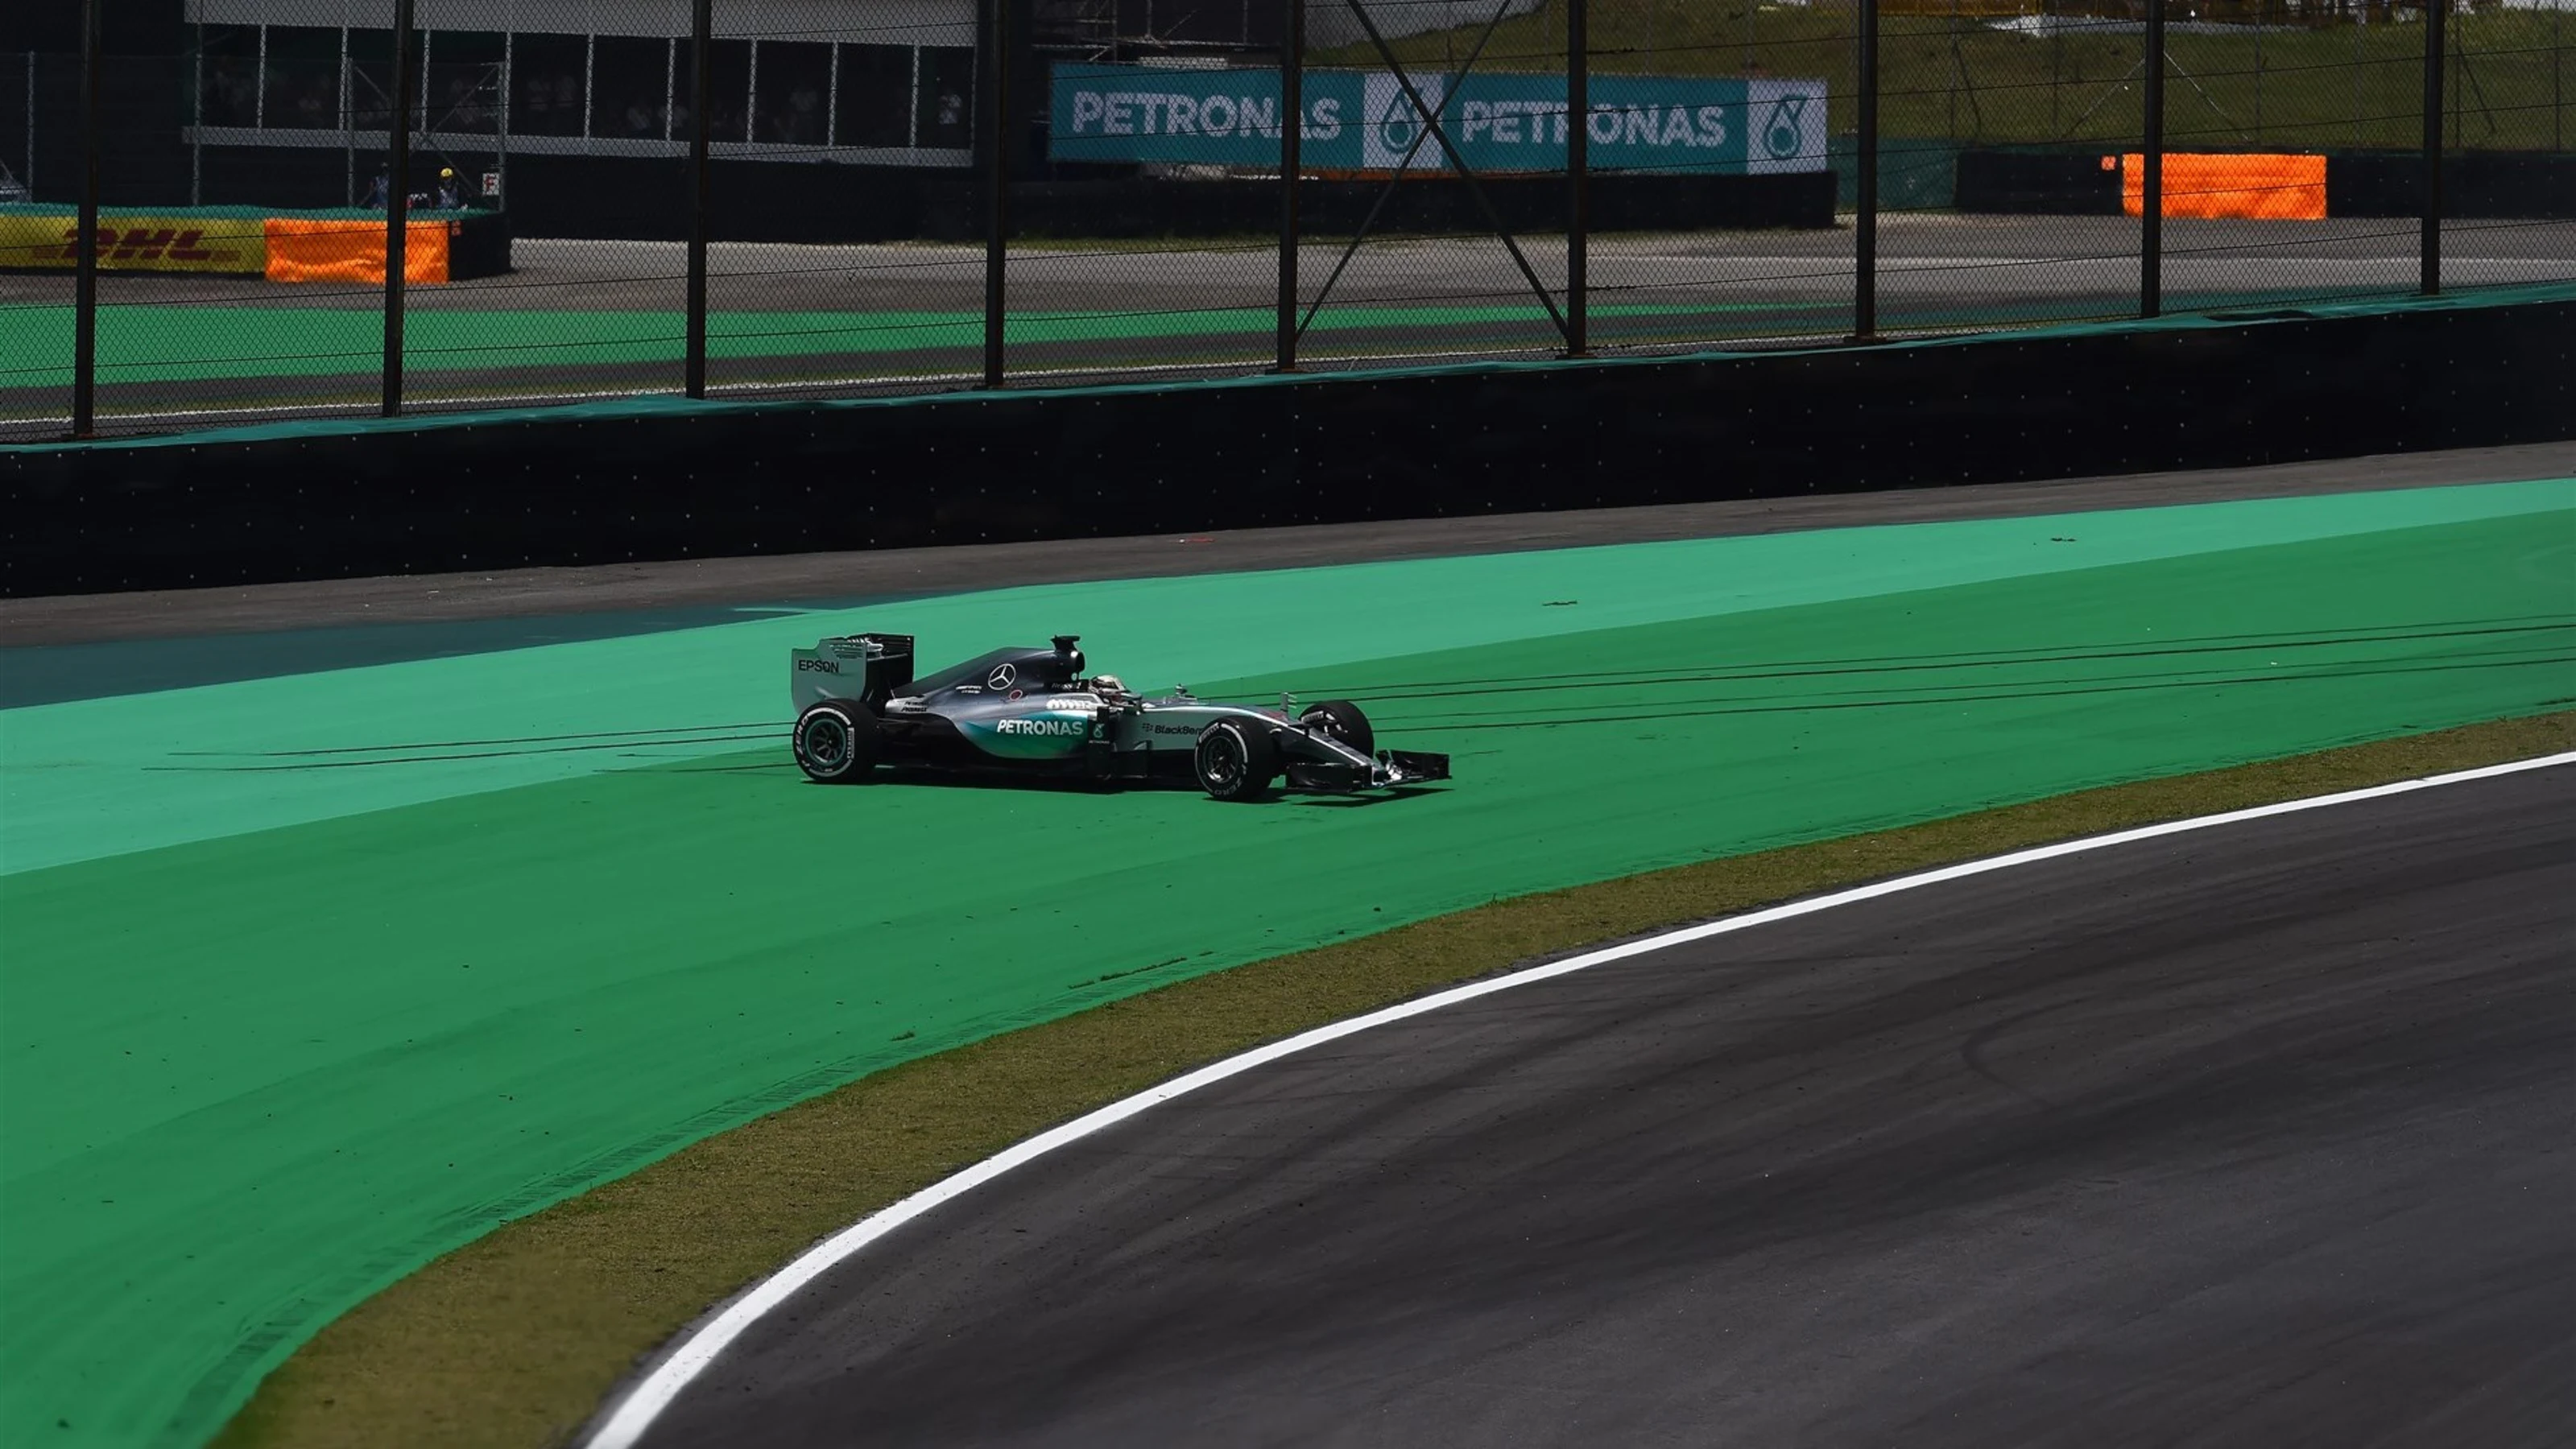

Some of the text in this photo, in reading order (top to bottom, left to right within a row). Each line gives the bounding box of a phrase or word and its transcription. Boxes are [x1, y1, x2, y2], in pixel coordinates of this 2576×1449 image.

[62, 229, 212, 261] DHL
[798, 660, 839, 673] EPSON
[996, 719, 1084, 736] PETRONAS
[1155, 724, 1206, 736] BlackBerr
